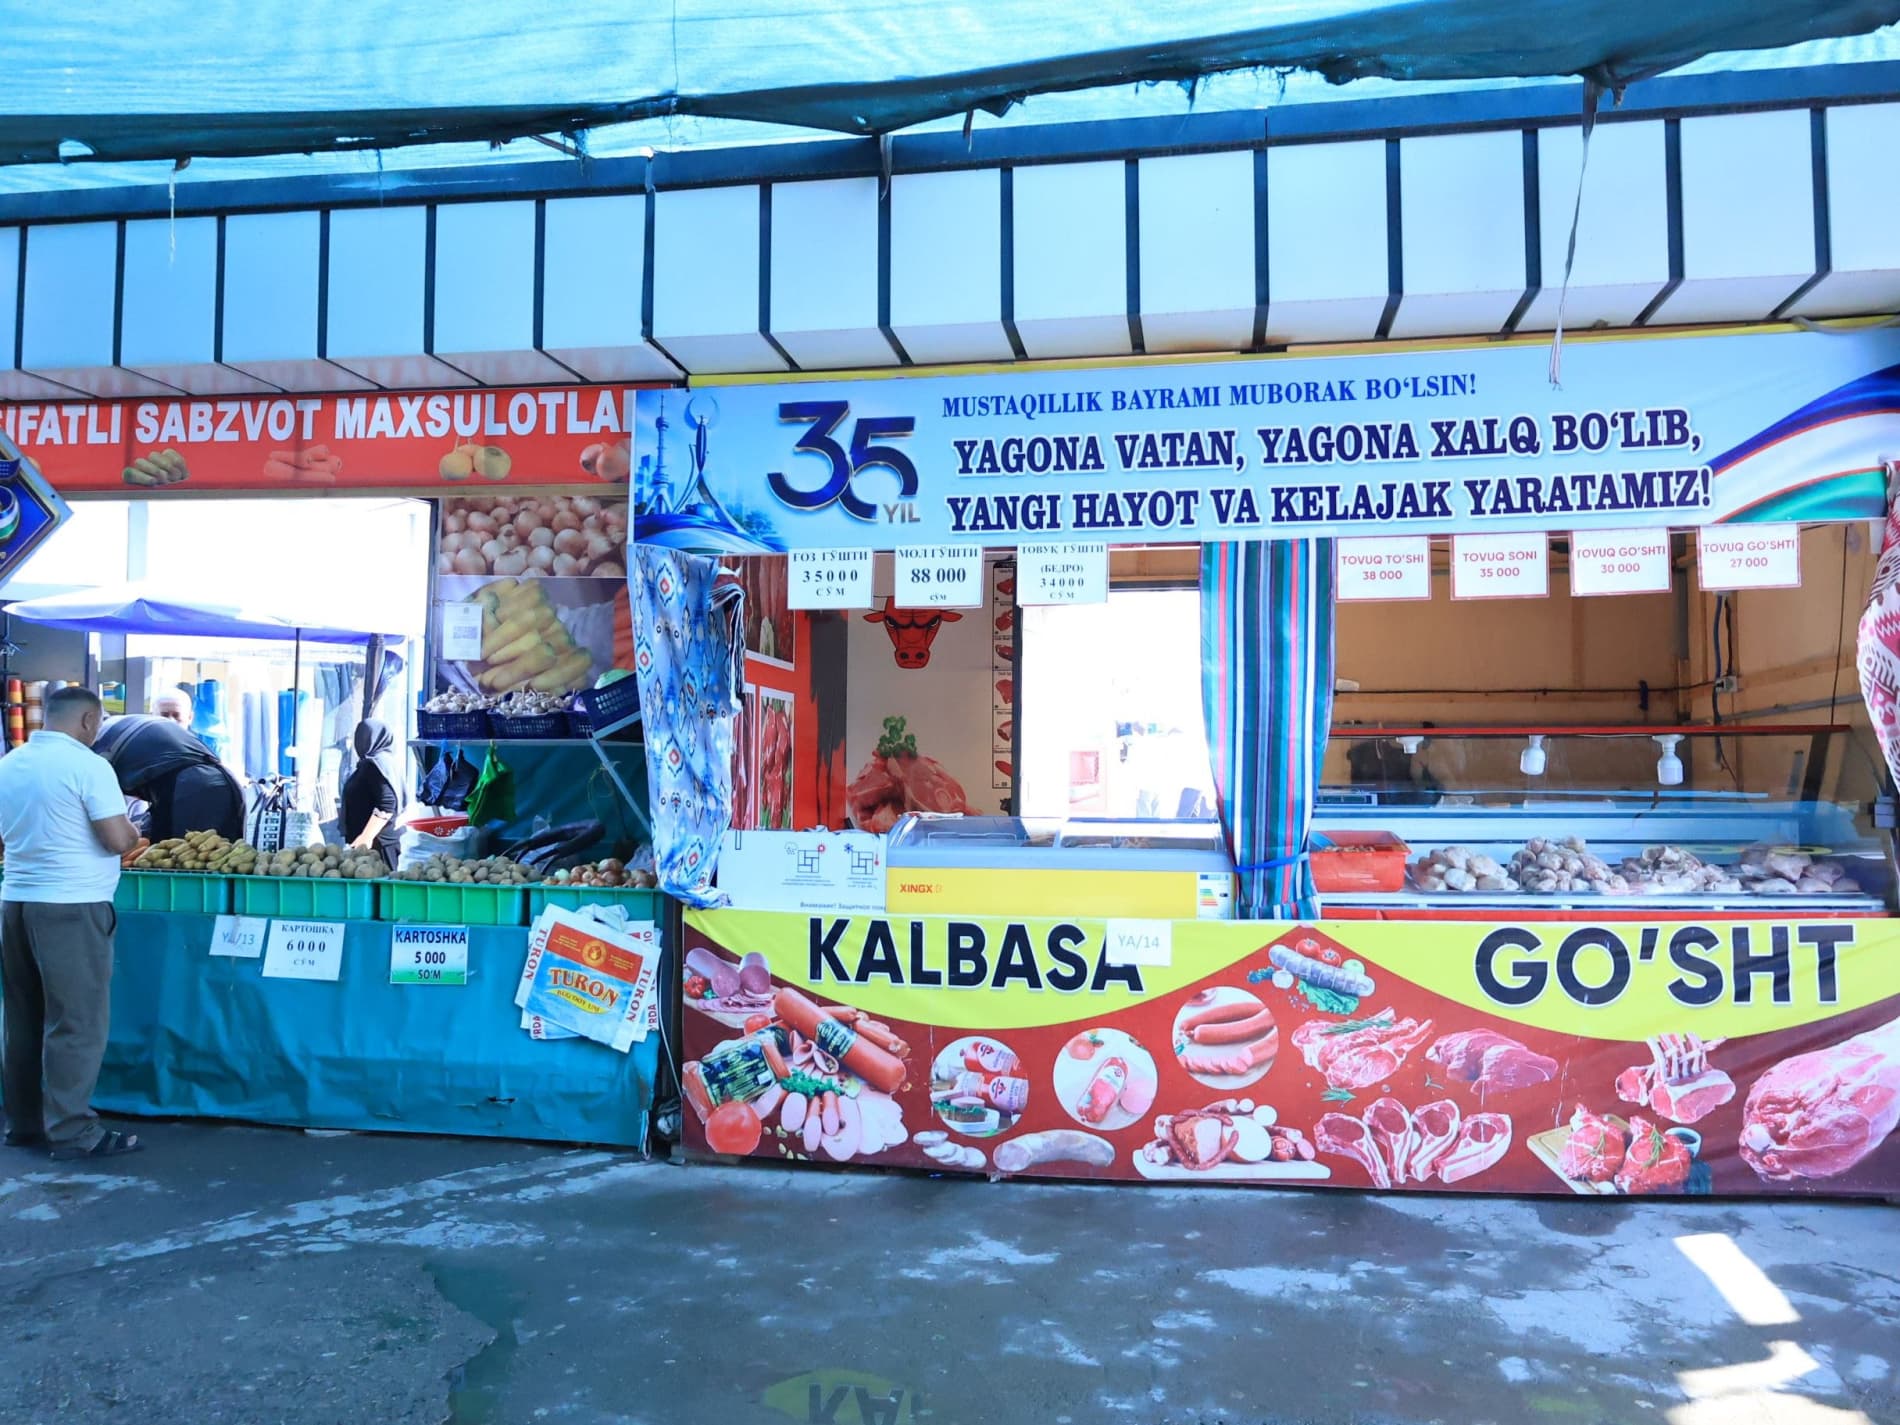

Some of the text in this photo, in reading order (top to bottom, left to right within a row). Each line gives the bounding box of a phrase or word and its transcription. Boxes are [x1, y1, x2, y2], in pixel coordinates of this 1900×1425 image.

[942, 373, 1476, 420] MUSTAQILLIK BAYRAMI MUBORAK BO‘LSIN!
[0, 403, 122, 445] IFATLI
[135, 399, 322, 443] SABZVOT
[953, 435, 1105, 475] YAGONA
[1114, 430, 1246, 471] VATAN,
[1257, 423, 1420, 464] YAGONA
[1430, 416, 1541, 457] XALQ
[767, 400, 919, 522] 35
[946, 467, 1711, 532] YANGI HAYOT VA KELAJAK YARATAMIZ!
[883, 503, 921, 524] YIL
[898, 549, 926, 559] МОЛ
[1577, 547, 1617, 559] TOVUQ
[1704, 542, 1744, 553] TOVUQ
[1341, 555, 1382, 566] TOVUQ
[1463, 551, 1537, 563] TOVUQ SONI
[1730, 557, 1768, 568] 27 000
[910, 567, 966, 583] 88 000
[1362, 570, 1403, 580] 38 000
[1480, 567, 1520, 578] 35 000
[1601, 563, 1640, 574] 30 000
[281, 924, 335, 935] КАРТОШКА
[395, 930, 467, 944] KARTOSHKA
[1117, 934, 1160, 950] YA/14
[523, 928, 549, 981] TURON
[1475, 925, 1855, 1005] GO'SHT
[549, 968, 620, 1008] TURON
[625, 968, 653, 1023] TURON
